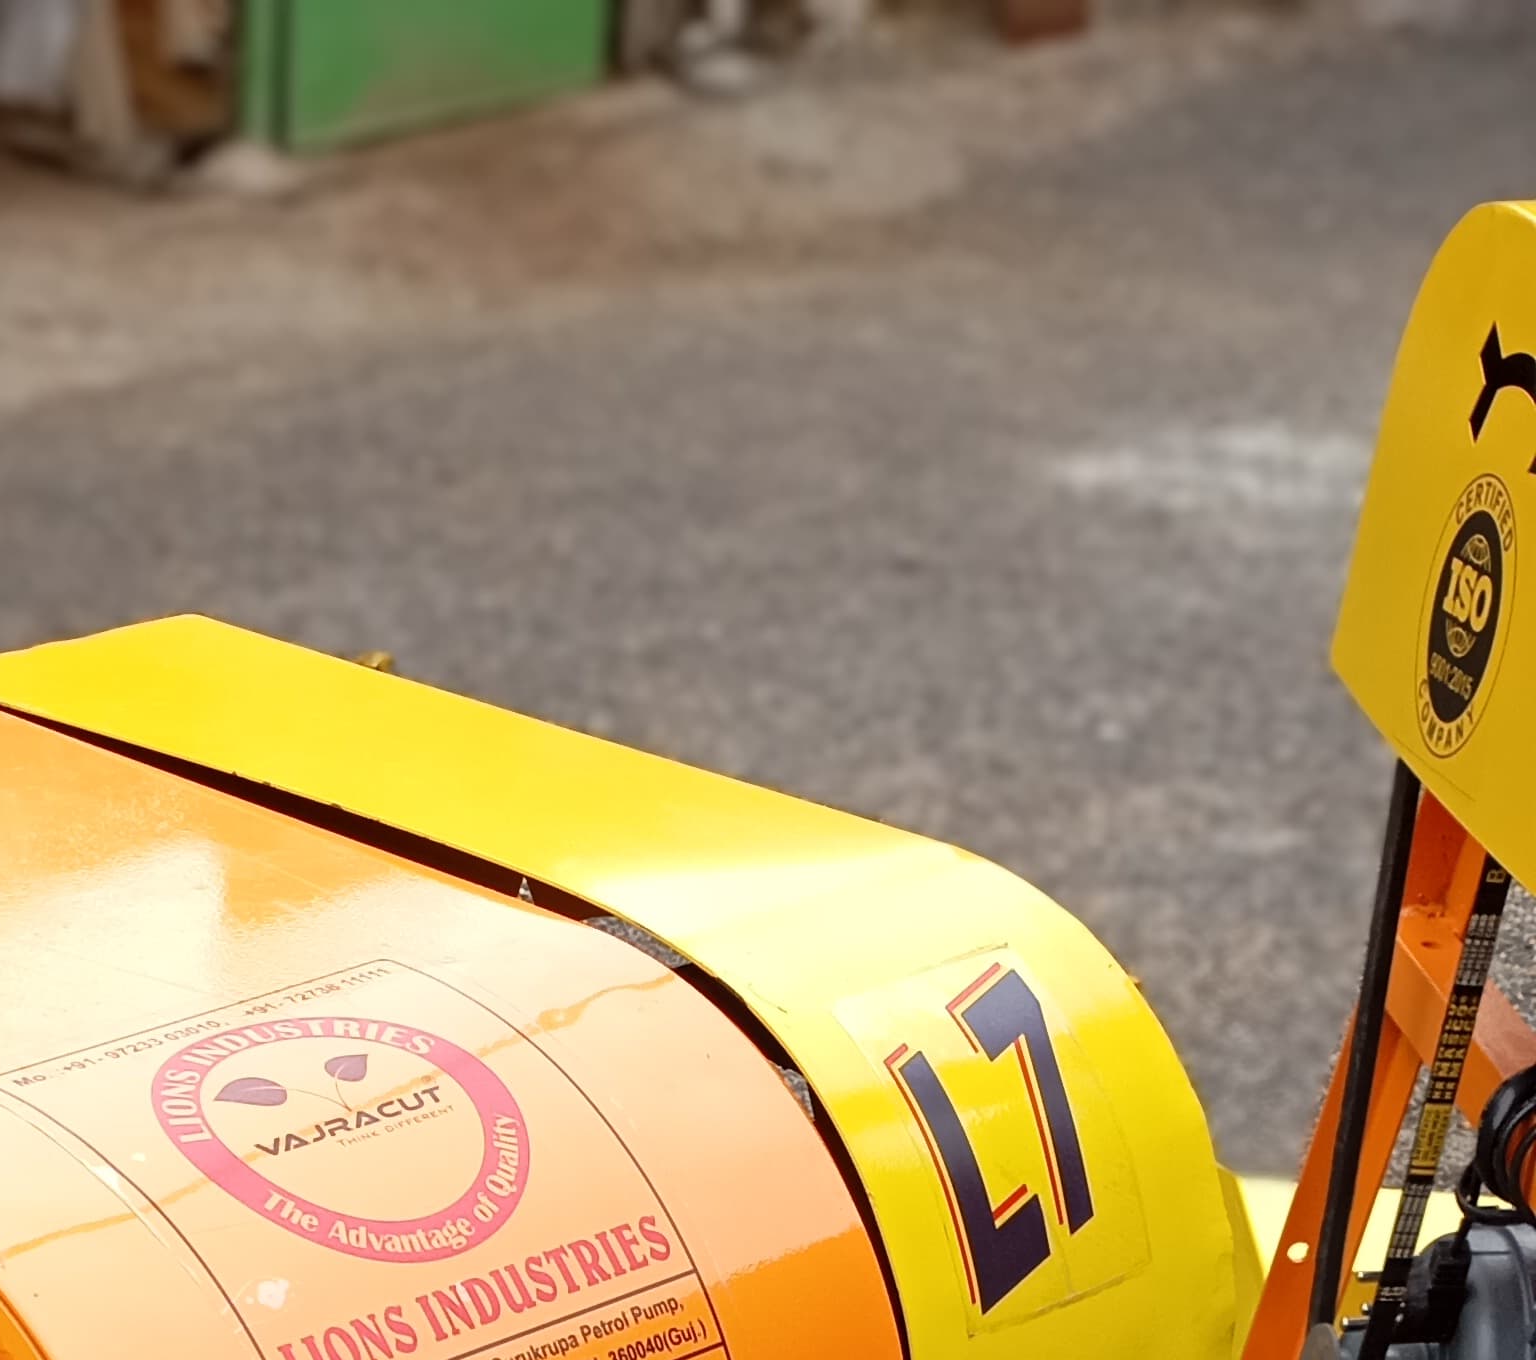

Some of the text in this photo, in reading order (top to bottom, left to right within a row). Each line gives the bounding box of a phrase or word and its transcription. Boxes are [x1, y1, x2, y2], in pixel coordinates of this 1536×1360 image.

[1455, 481, 1514, 552] CERTIFIED
[1441, 556, 1493, 632] ISO
[1418, 678, 1474, 750] COMPANY
[160, 1017, 437, 1145] LIONS INDUSTRIES
[254, 1085, 441, 1156] VAJRACUT
[336, 1103, 456, 1150] THINK DIFFERENT
[883, 962, 1095, 1316] L7
[264, 1111, 522, 1255] The Advantage of Quality
[414, 1213, 672, 1343] INDUSTRIES
[580, 1315, 631, 1351] Petrol
[632, 1294, 685, 1330] Pump,
